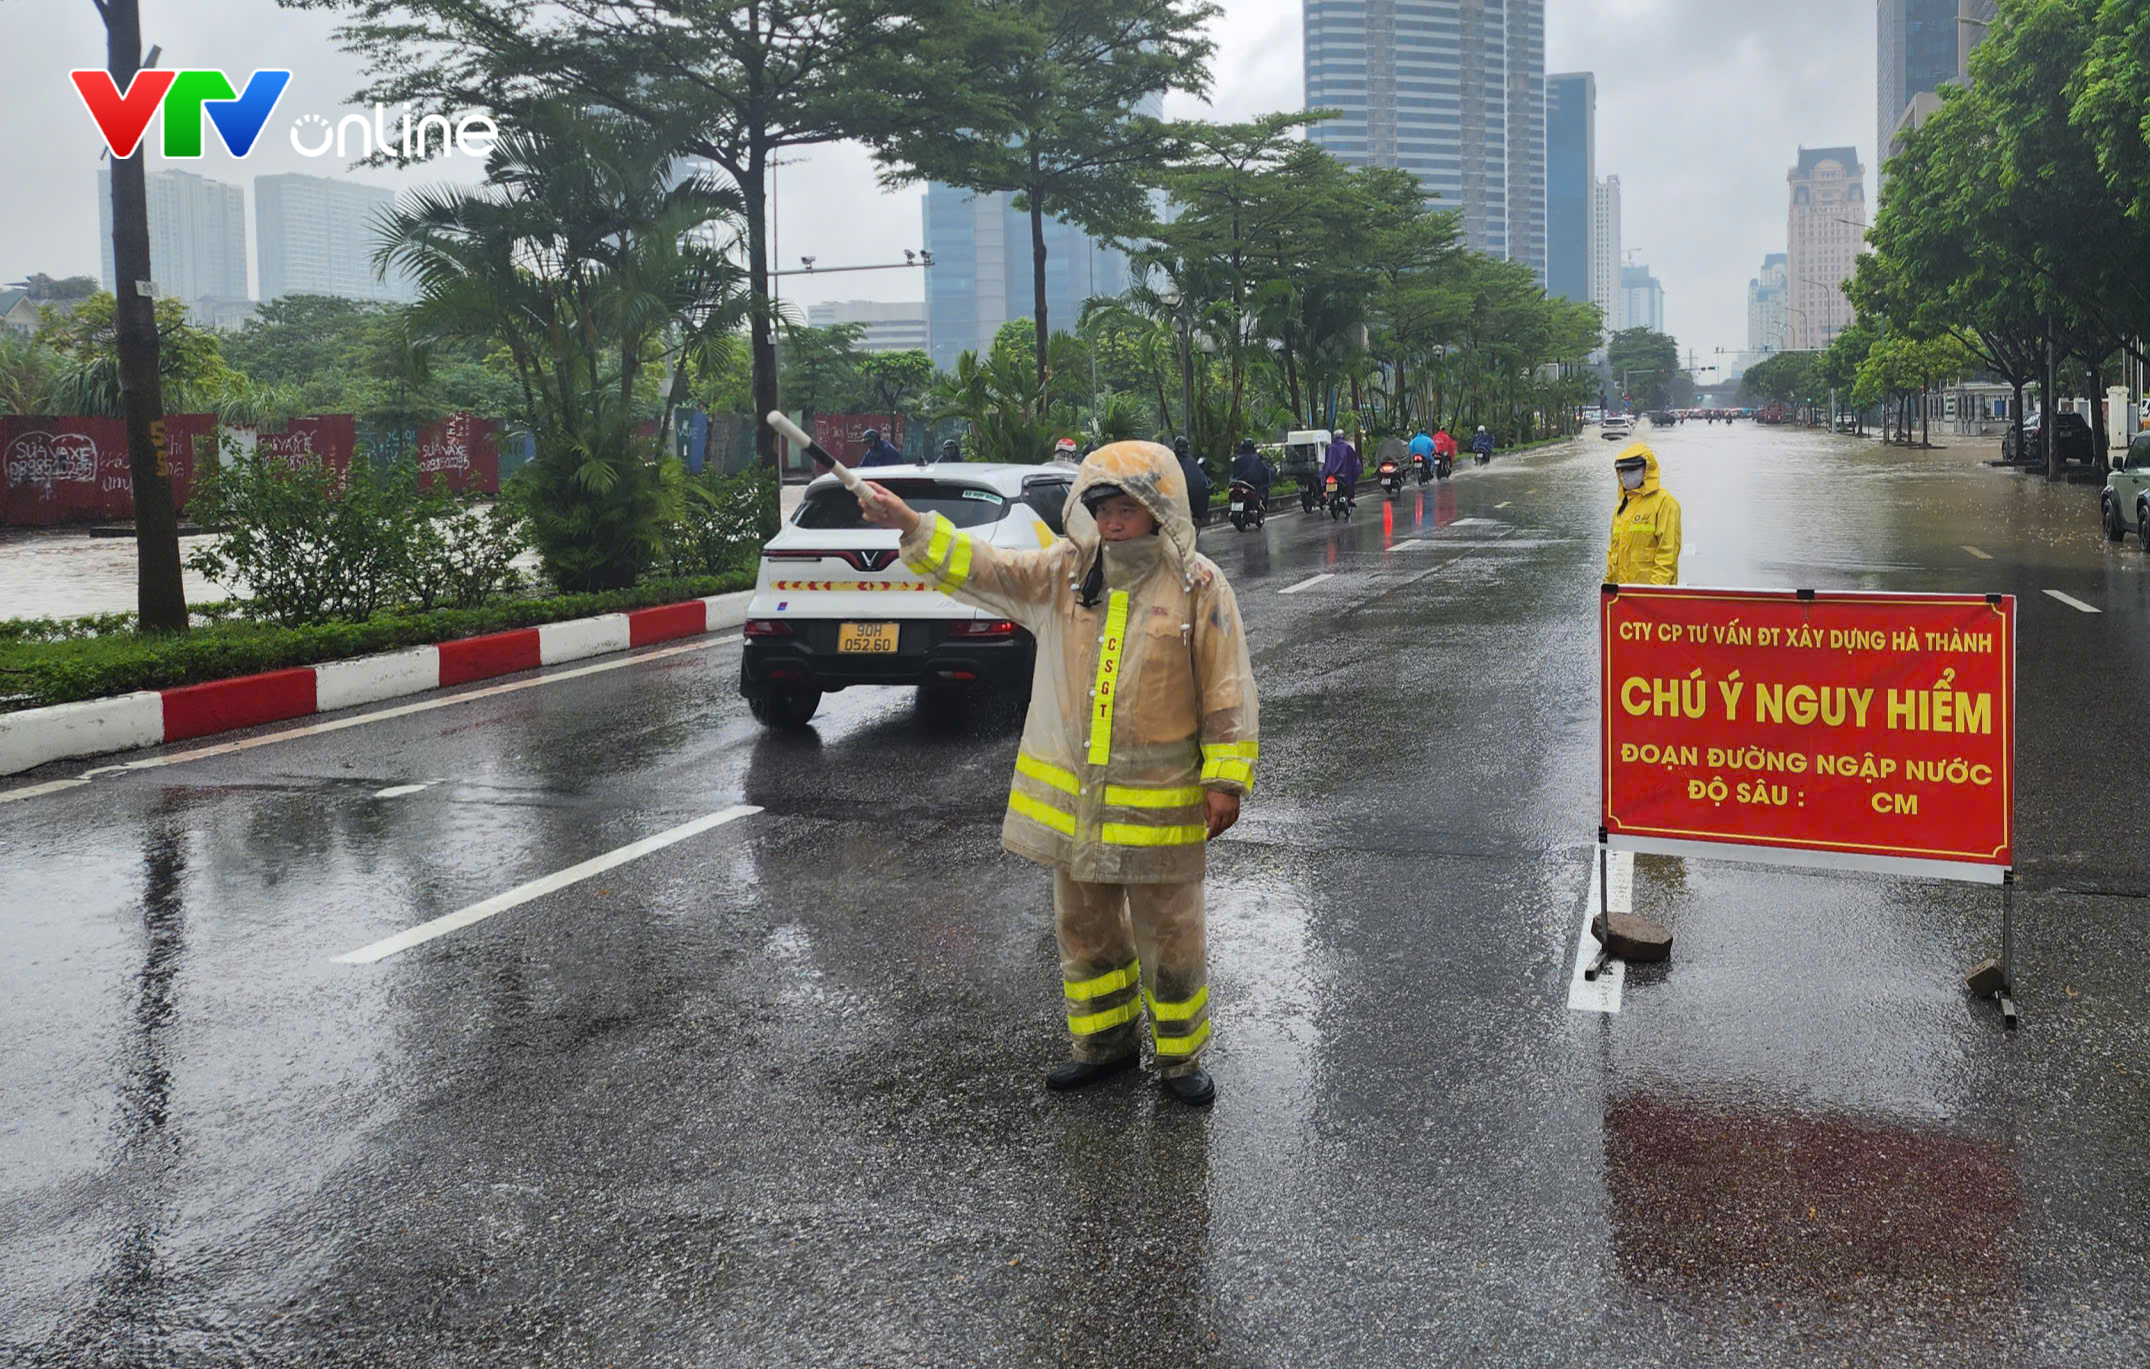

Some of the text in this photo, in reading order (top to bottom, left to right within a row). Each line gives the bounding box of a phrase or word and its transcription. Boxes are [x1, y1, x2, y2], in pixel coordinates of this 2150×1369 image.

[845, 638, 891, 652] 052.60
[857, 624, 882, 637] 90H
[1620, 618, 1992, 655] CTY CP TƯ VẤN ĐT XÂY DỰNG HÀ THÀNH
[1100, 637, 1117, 718] CSGT
[1620, 667, 1992, 734] CHÚ Ý NGUY HIỂM
[1621, 743, 1993, 786] ĐOẠN ĐƯỜNG NGẬP NƯỚC
[1688, 776, 1729, 807] ĐỘ
[1737, 778, 1789, 806] SÂU
[1871, 792, 1918, 815] CM
